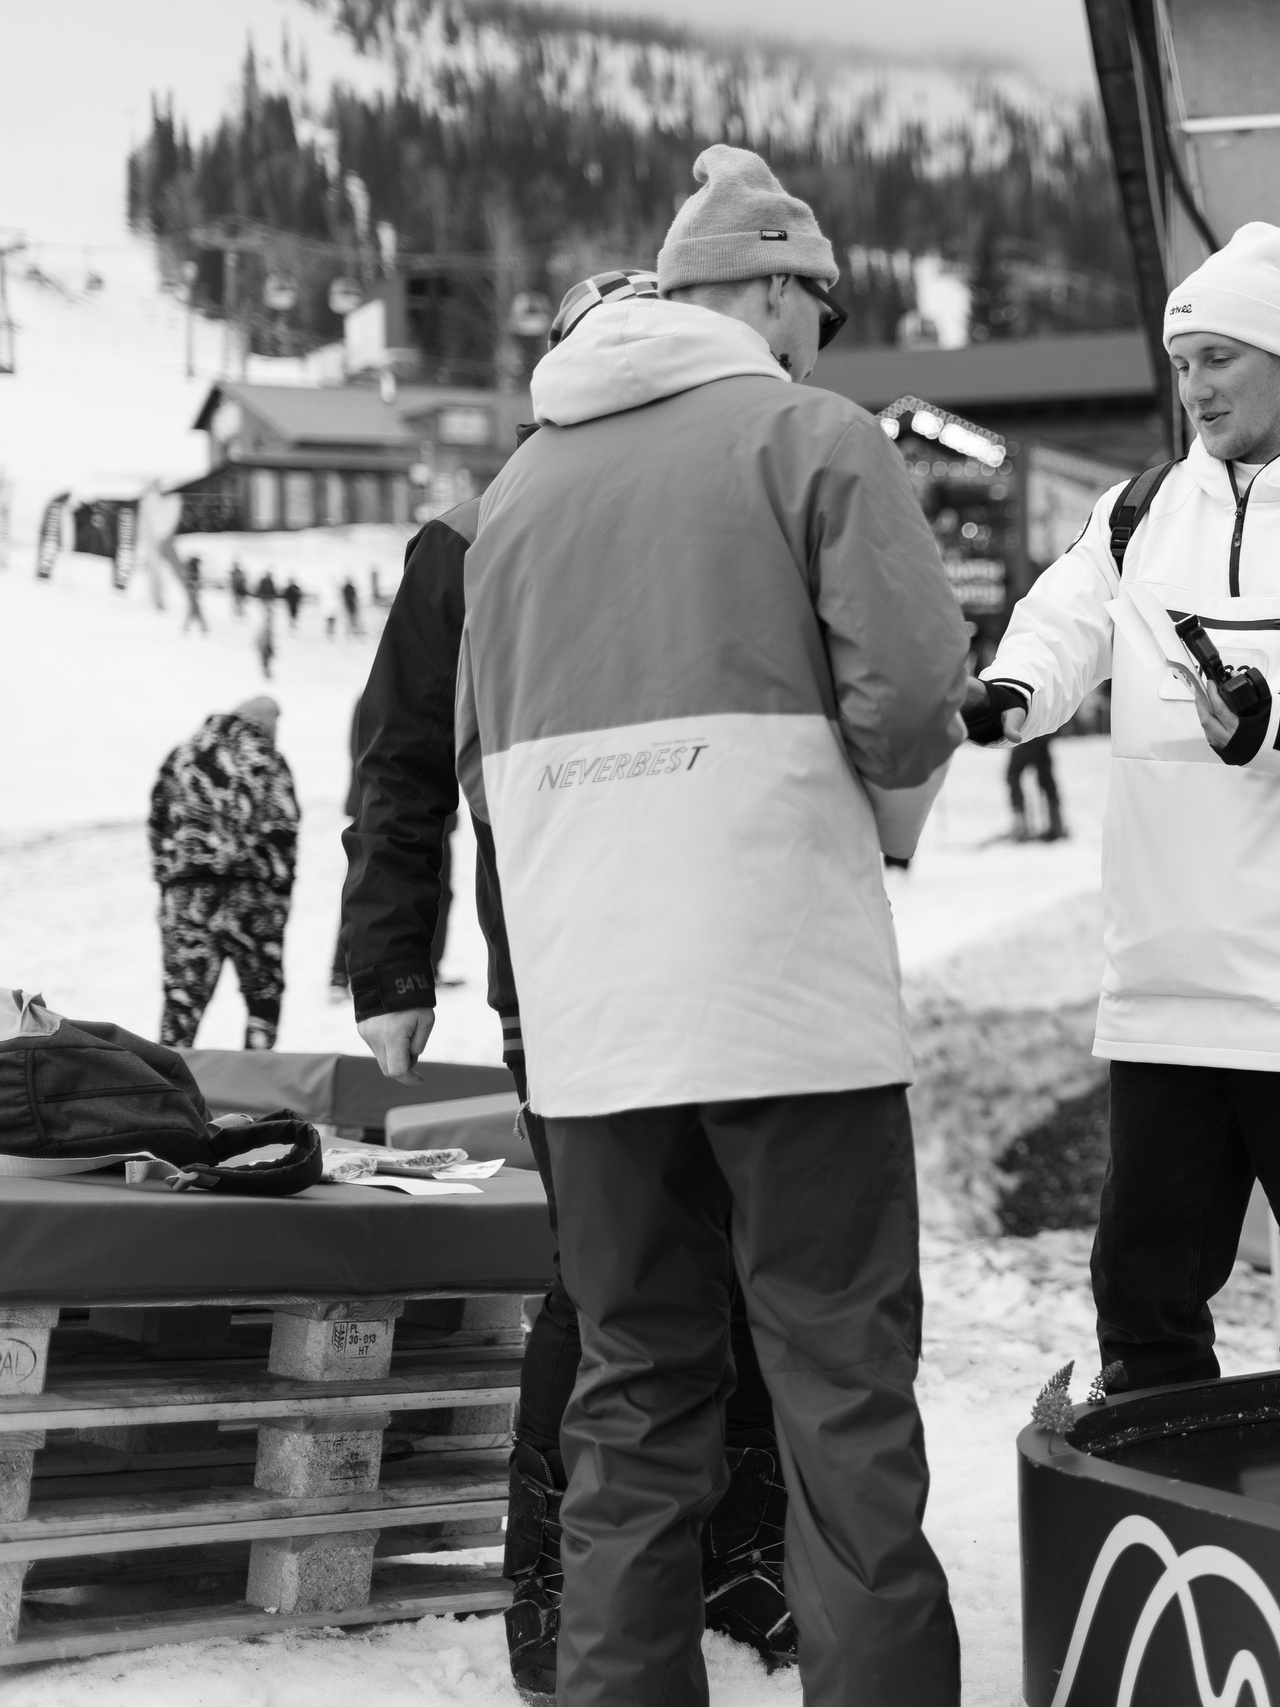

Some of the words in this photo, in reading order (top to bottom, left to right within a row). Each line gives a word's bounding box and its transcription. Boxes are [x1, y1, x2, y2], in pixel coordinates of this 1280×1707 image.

[537, 744, 710, 792] NEVERBEST
[350, 1323, 359, 1334] PL
[358, 1345, 370, 1355] HT
[0, 1350, 26, 1377] AL
